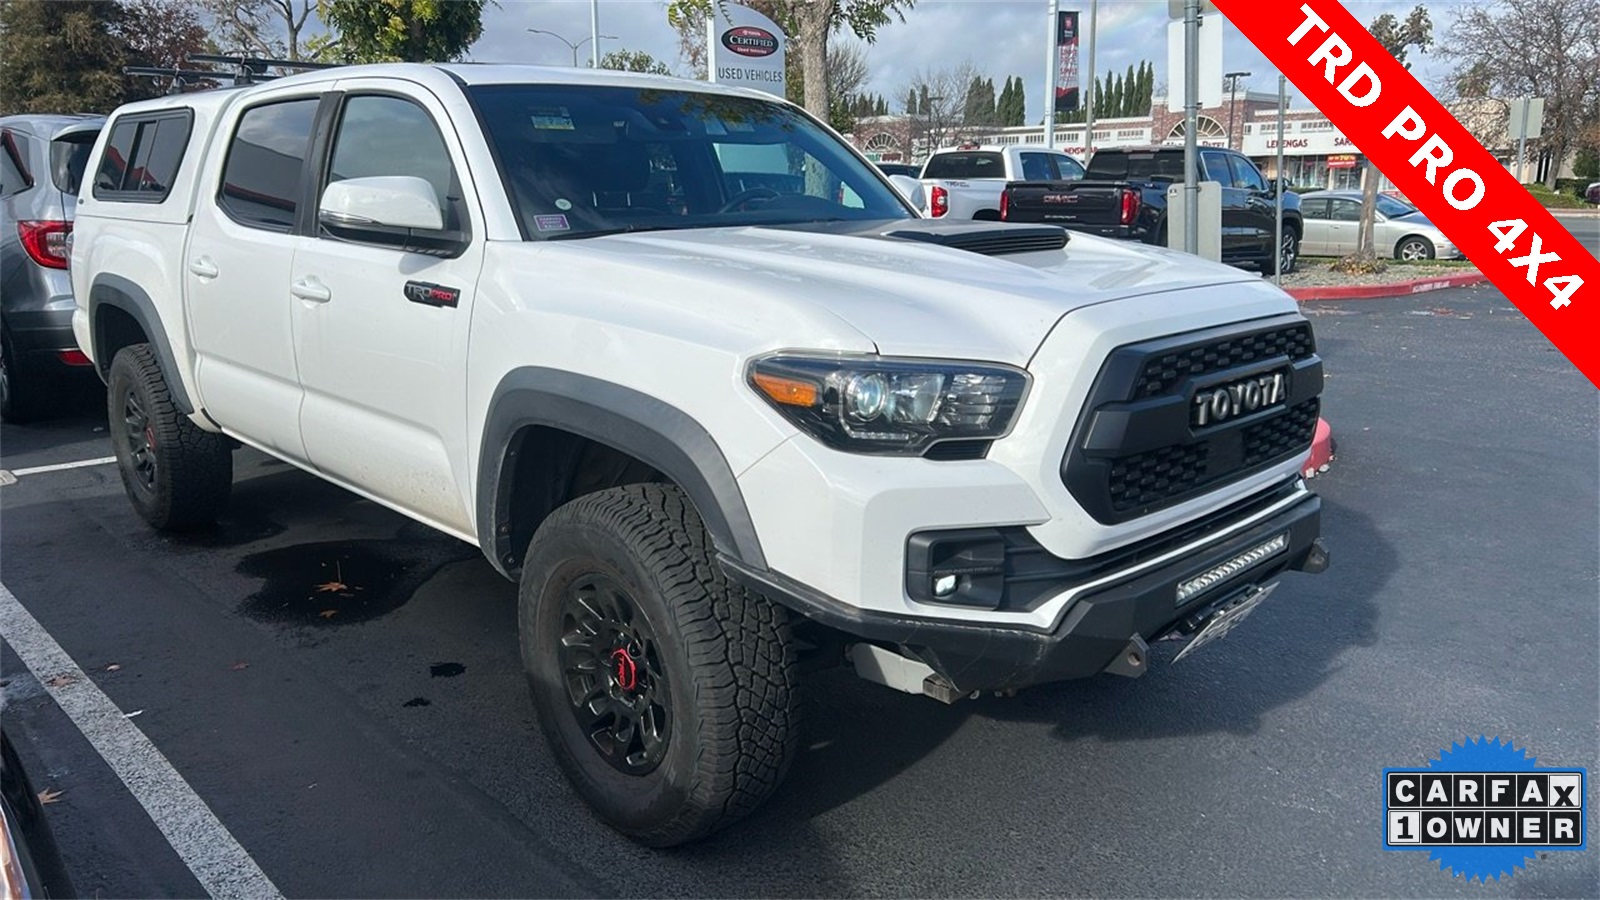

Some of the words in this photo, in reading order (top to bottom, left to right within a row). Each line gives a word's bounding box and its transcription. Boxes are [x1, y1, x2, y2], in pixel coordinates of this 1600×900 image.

[729, 35, 774, 47] CERTIFIED
[718, 67, 743, 80] USED
[744, 69, 783, 82] VEHICLES
[406, 283, 431, 300] TRD
[431, 288, 454, 301] PRO
[1196, 373, 1286, 425] TOYOTA
